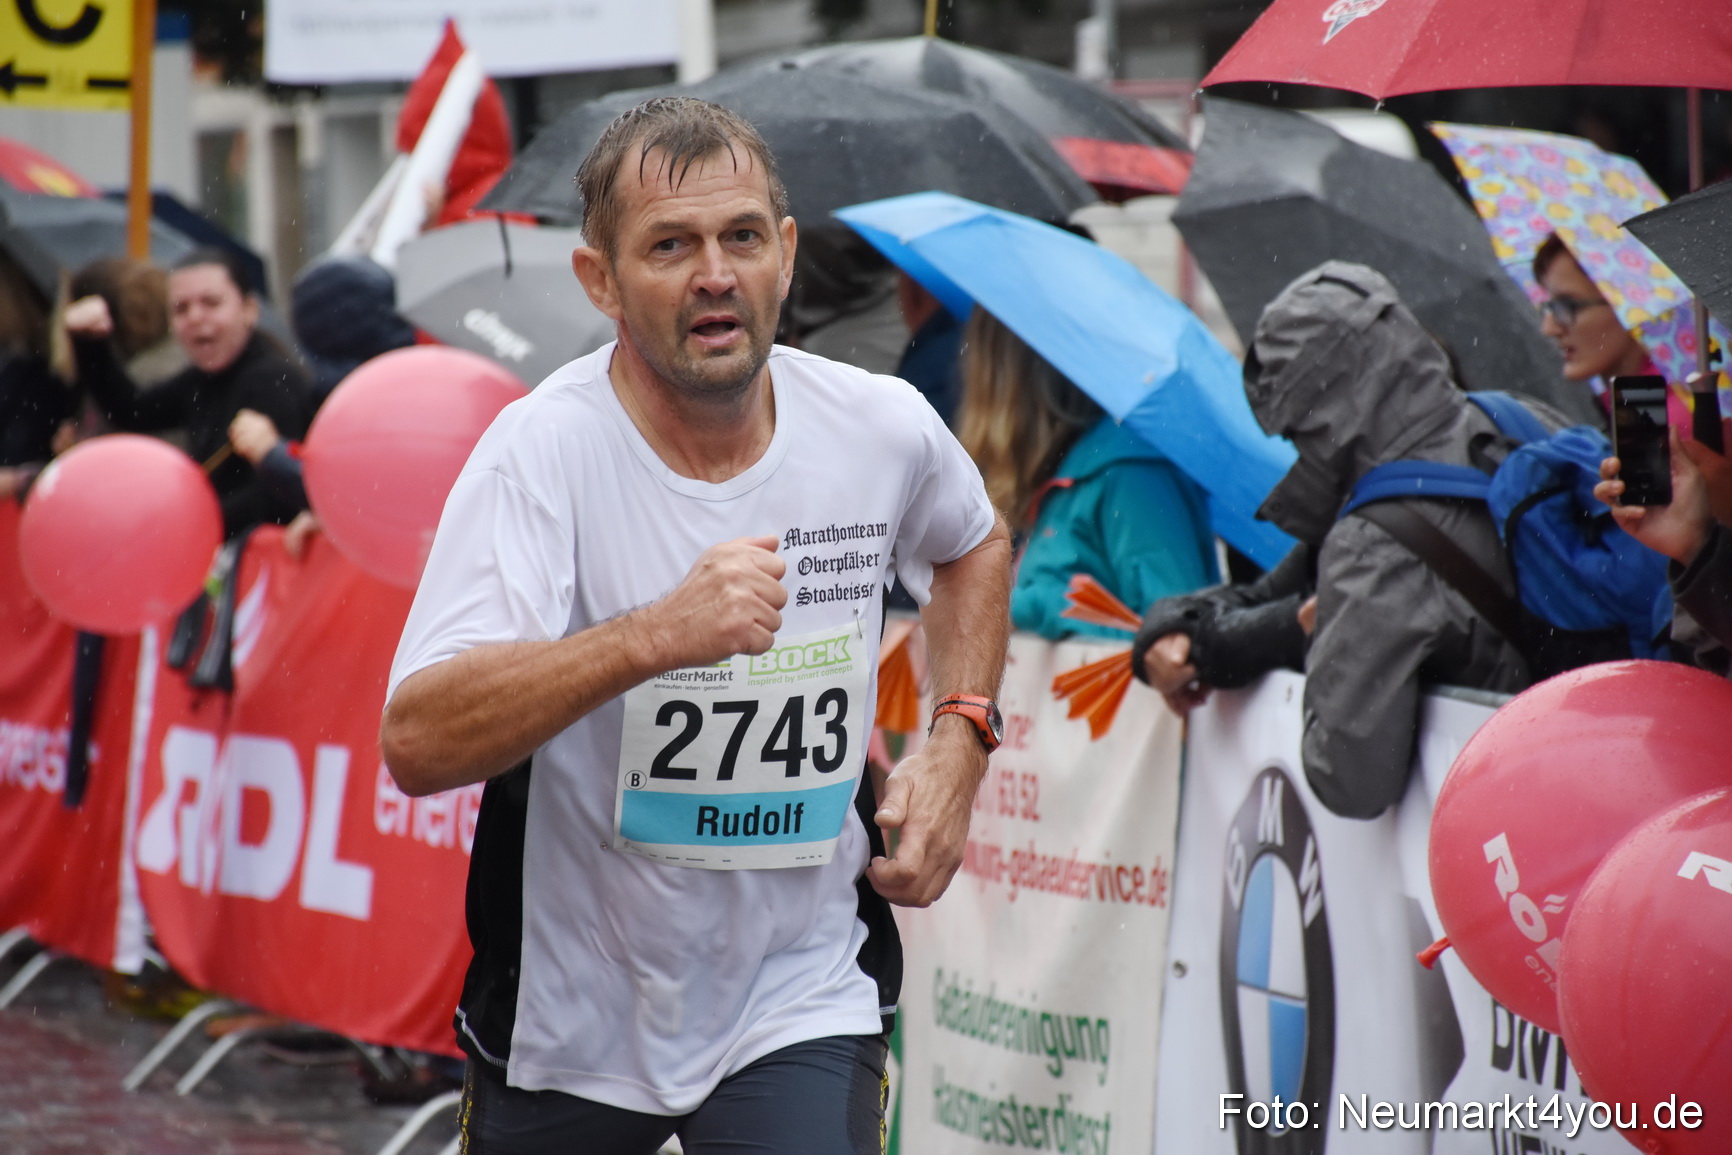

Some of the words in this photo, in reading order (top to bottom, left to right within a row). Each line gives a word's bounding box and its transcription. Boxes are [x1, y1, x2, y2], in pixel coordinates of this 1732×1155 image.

[783, 523, 887, 550] Marathonteam
[798, 551, 880, 576] Oberpfälzer
[796, 582, 877, 607] Stoabeisse
[749, 634, 852, 676] BOCK
[748, 675, 782, 687] inspired
[785, 674, 795, 684] by
[797, 670, 819, 680] smart
[821, 664, 853, 676] concepts
[649, 687, 849, 781] 2743
[631, 773, 640, 787] B
[696, 802, 805, 837] Rudolf
[1224, 774, 1324, 930] BMW
